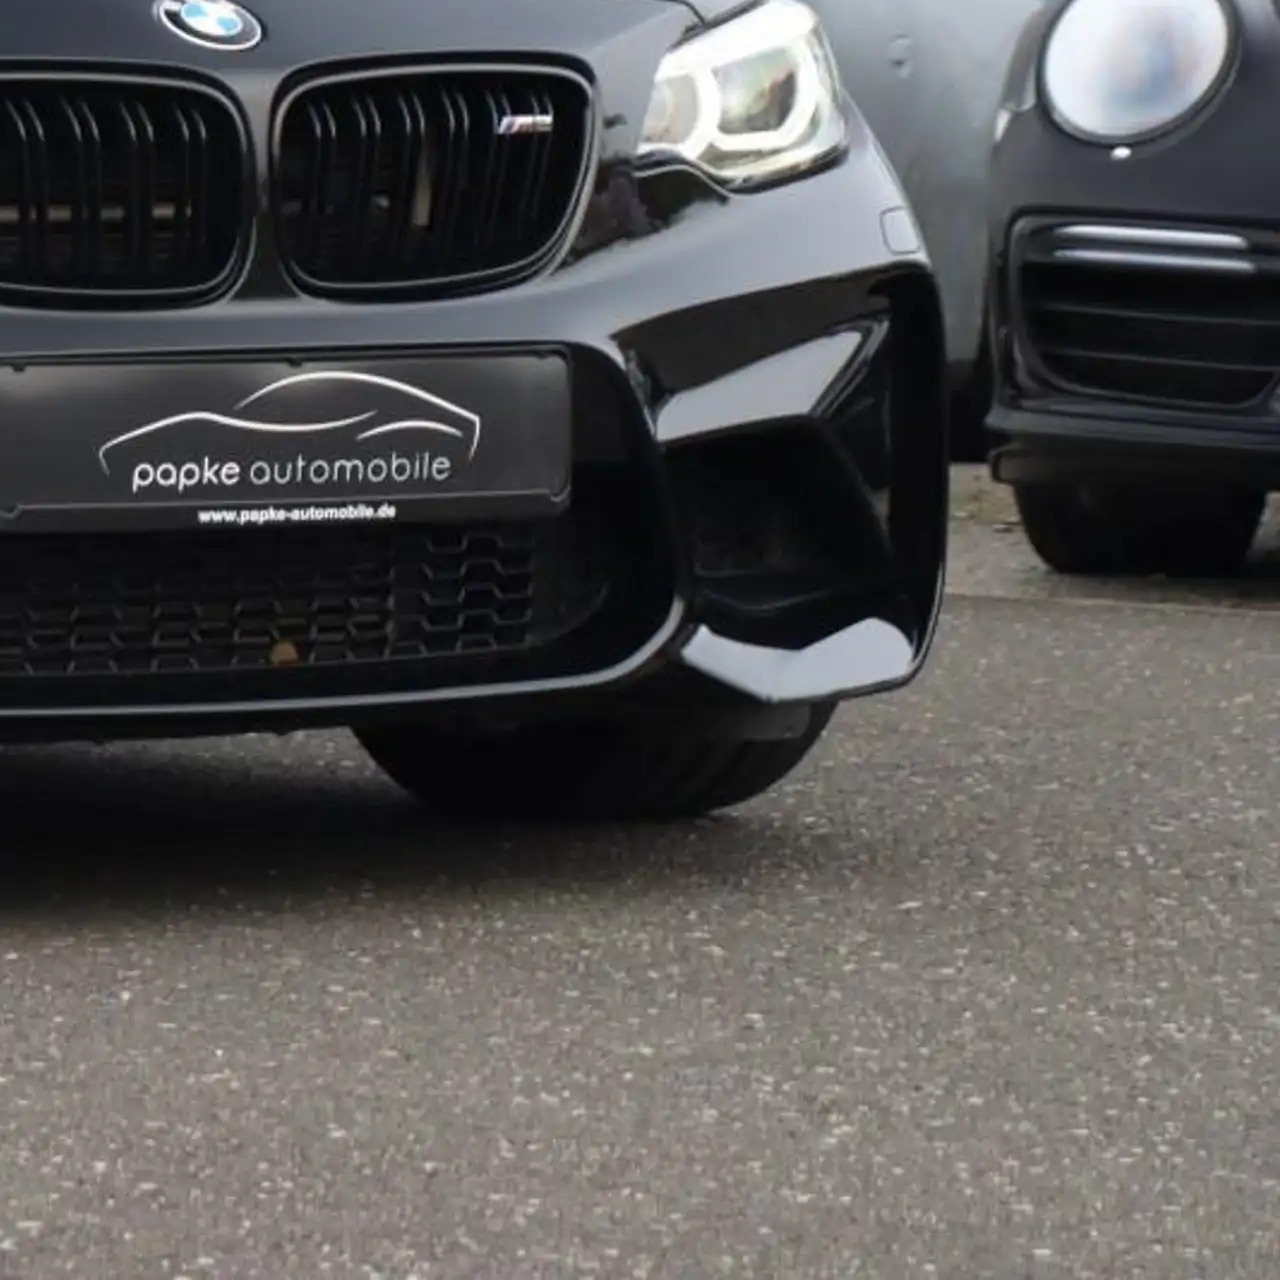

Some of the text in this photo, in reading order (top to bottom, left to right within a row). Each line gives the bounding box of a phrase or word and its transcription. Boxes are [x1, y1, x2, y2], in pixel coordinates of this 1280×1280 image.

[132, 451, 451, 494] papke automobile
[197, 502, 397, 525] www.papke-automobile.de
